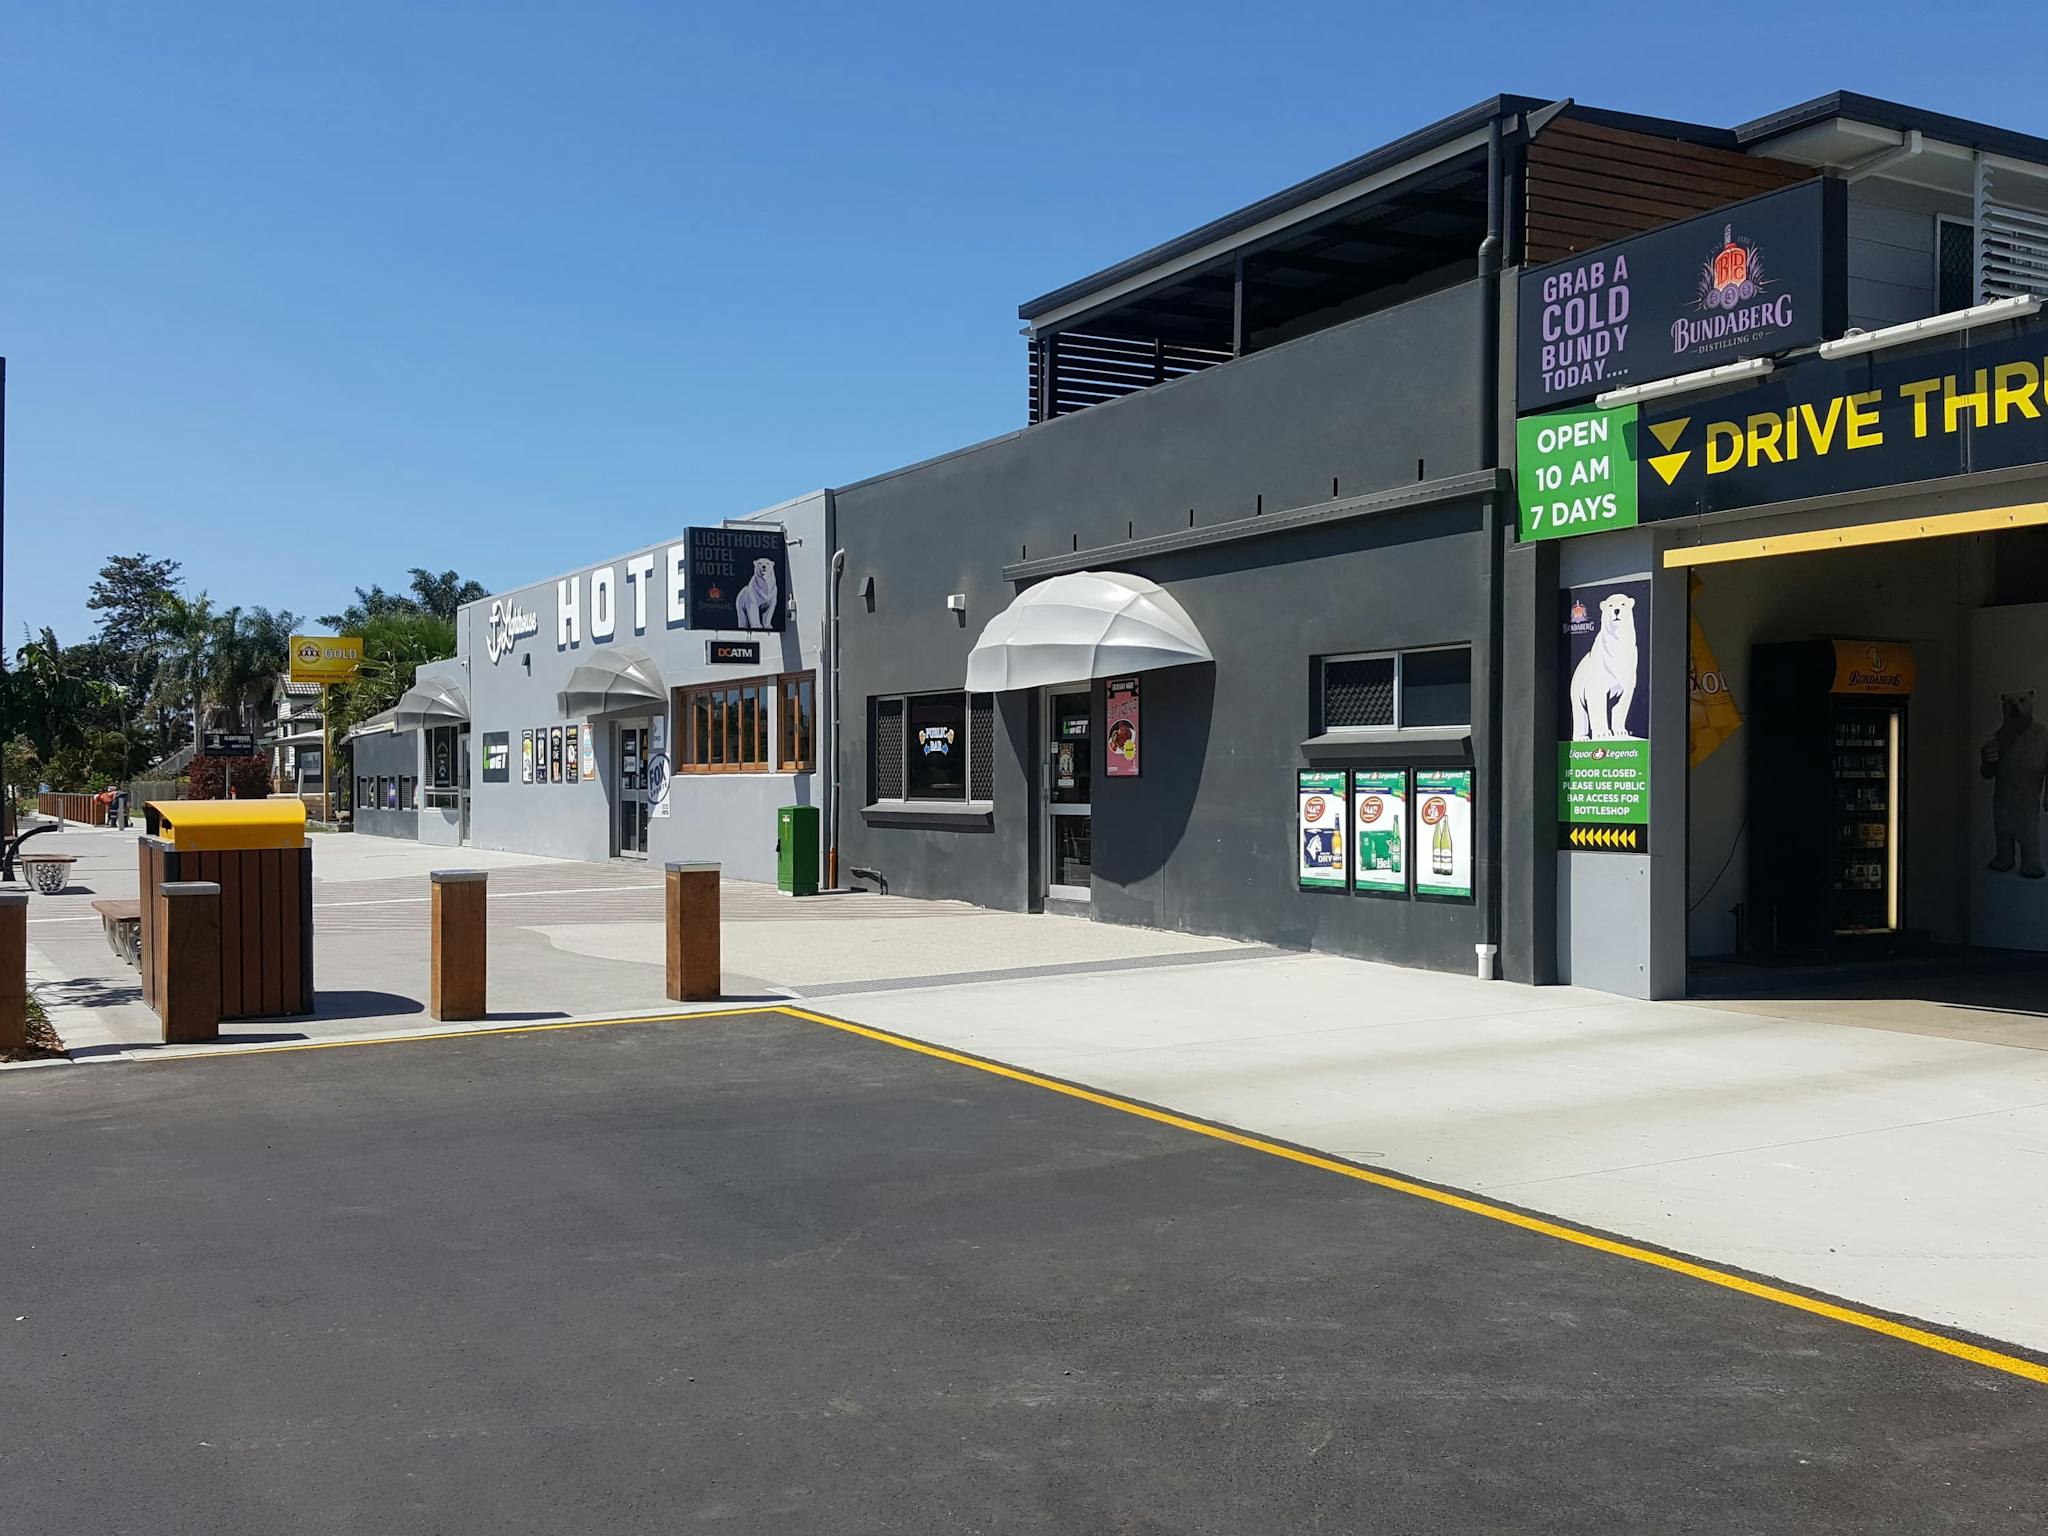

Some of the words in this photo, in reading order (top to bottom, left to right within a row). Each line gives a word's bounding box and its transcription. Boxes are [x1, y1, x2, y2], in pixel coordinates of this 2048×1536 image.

[1543, 262, 1605, 303] GRAB
[1613, 255, 1628, 282] A
[1543, 285, 1630, 342] COLD
[1671, 294, 1793, 353] BUNDABERG
[1542, 324, 1629, 371] BUNDY
[1698, 334, 1750, 354] DISTILLING
[1706, 389, 1884, 475] DRIVE
[1899, 357, 2048, 439] THR
[1537, 417, 1608, 453] OPEN
[1535, 465, 1562, 491] 10
[1570, 456, 1609, 486] AM
[1530, 505, 1544, 530] 7
[1552, 493, 1617, 527] DAYS
[695, 531, 778, 549] LIGHTHOUSE
[695, 546, 735, 562] HOTEL
[695, 561, 736, 577] MOTEL
[324, 647, 357, 659] GOLD
[1569, 749, 1593, 760] Liquor
[1606, 748, 1639, 760] Legends
[1566, 769, 1574, 778] IF
[1575, 769, 1600, 778] DOOR
[1602, 769, 1636, 778] CLOSED
[1563, 782, 1594, 790] PLEASE
[1596, 782, 1612, 790] USE
[1614, 782, 1646, 790] PUBLIC
[1567, 794, 1585, 802] BAR
[1586, 794, 1619, 803] ACCESS
[1621, 794, 1640, 803] FOR
[1574, 806, 1630, 815] BOTTLESHOP
[1318, 855, 1332, 863] DRY
